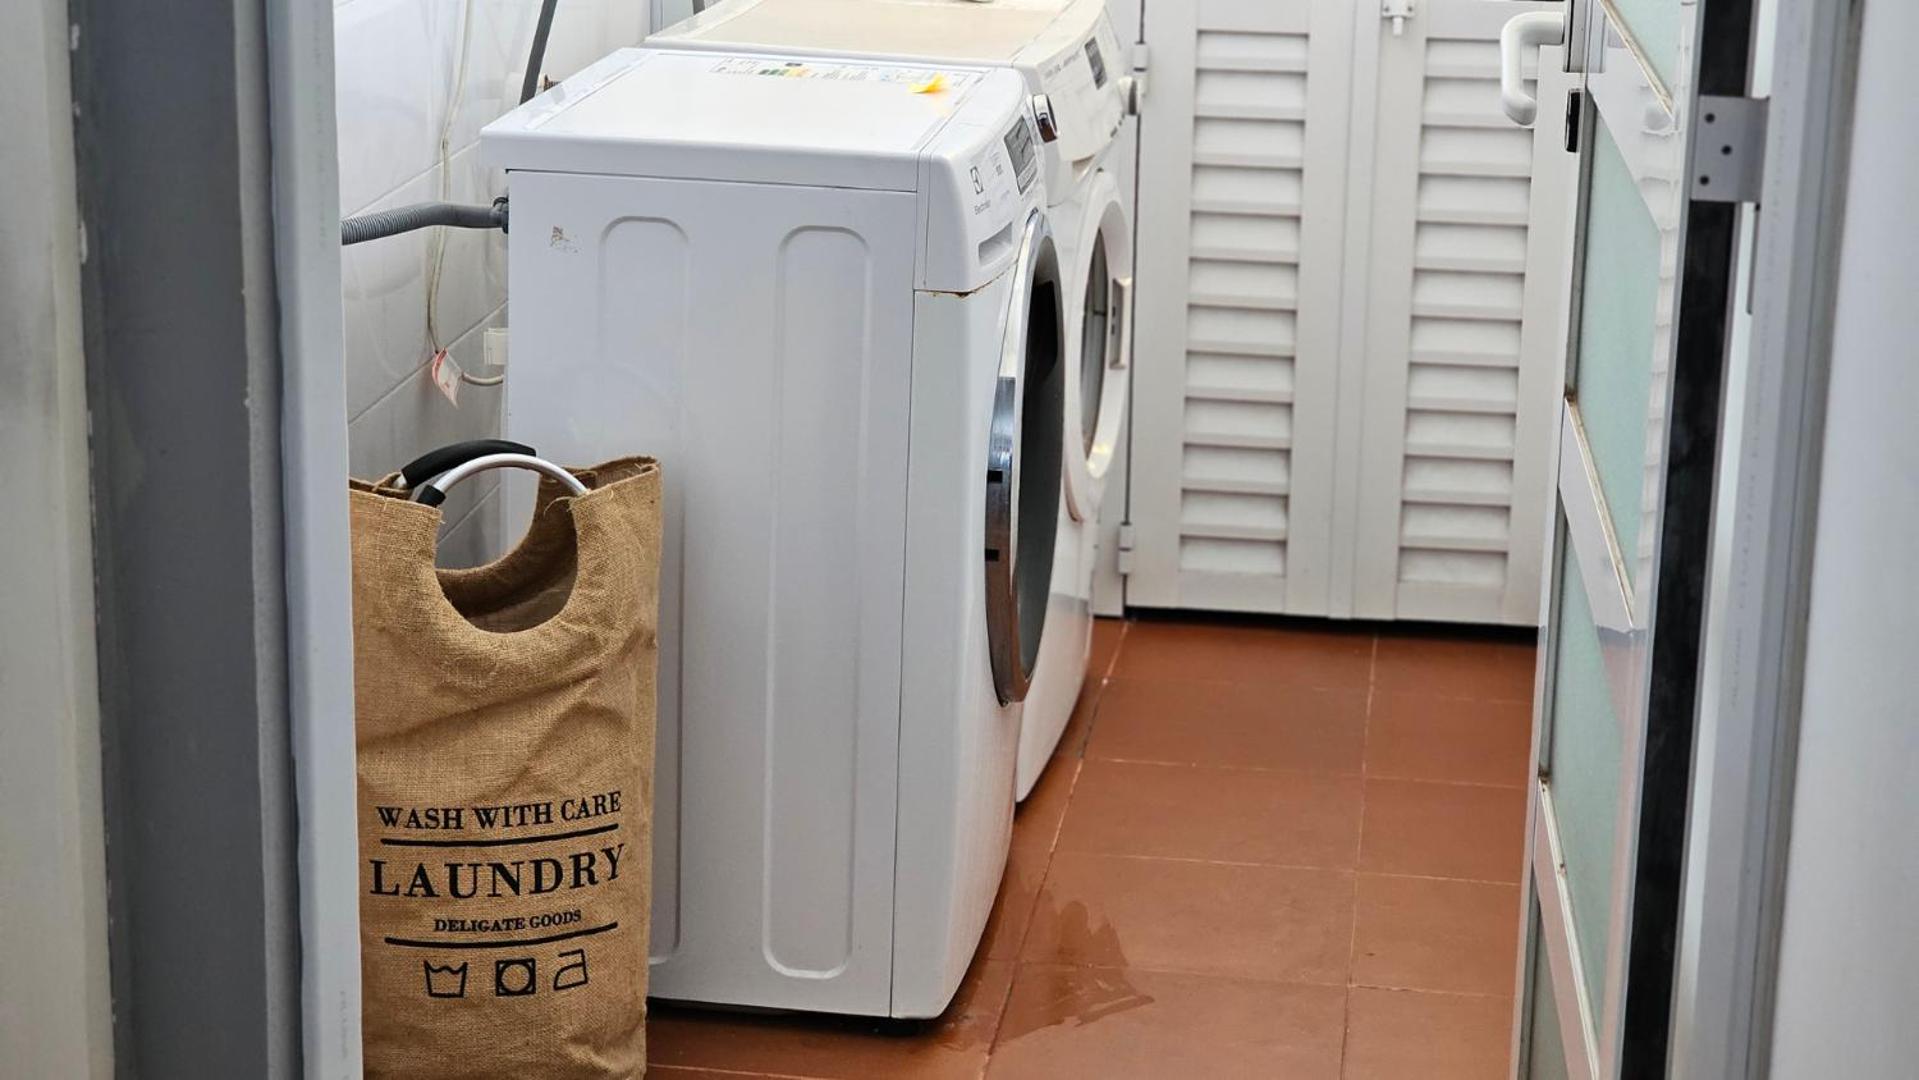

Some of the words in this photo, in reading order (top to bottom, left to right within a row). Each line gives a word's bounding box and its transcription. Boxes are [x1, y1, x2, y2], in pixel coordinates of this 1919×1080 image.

[375, 805, 465, 830] WASH
[471, 802, 553, 828] WITH
[561, 790, 622, 821] CARE
[369, 843, 625, 899] LAUNDRY
[529, 909, 582, 928] GOODS
